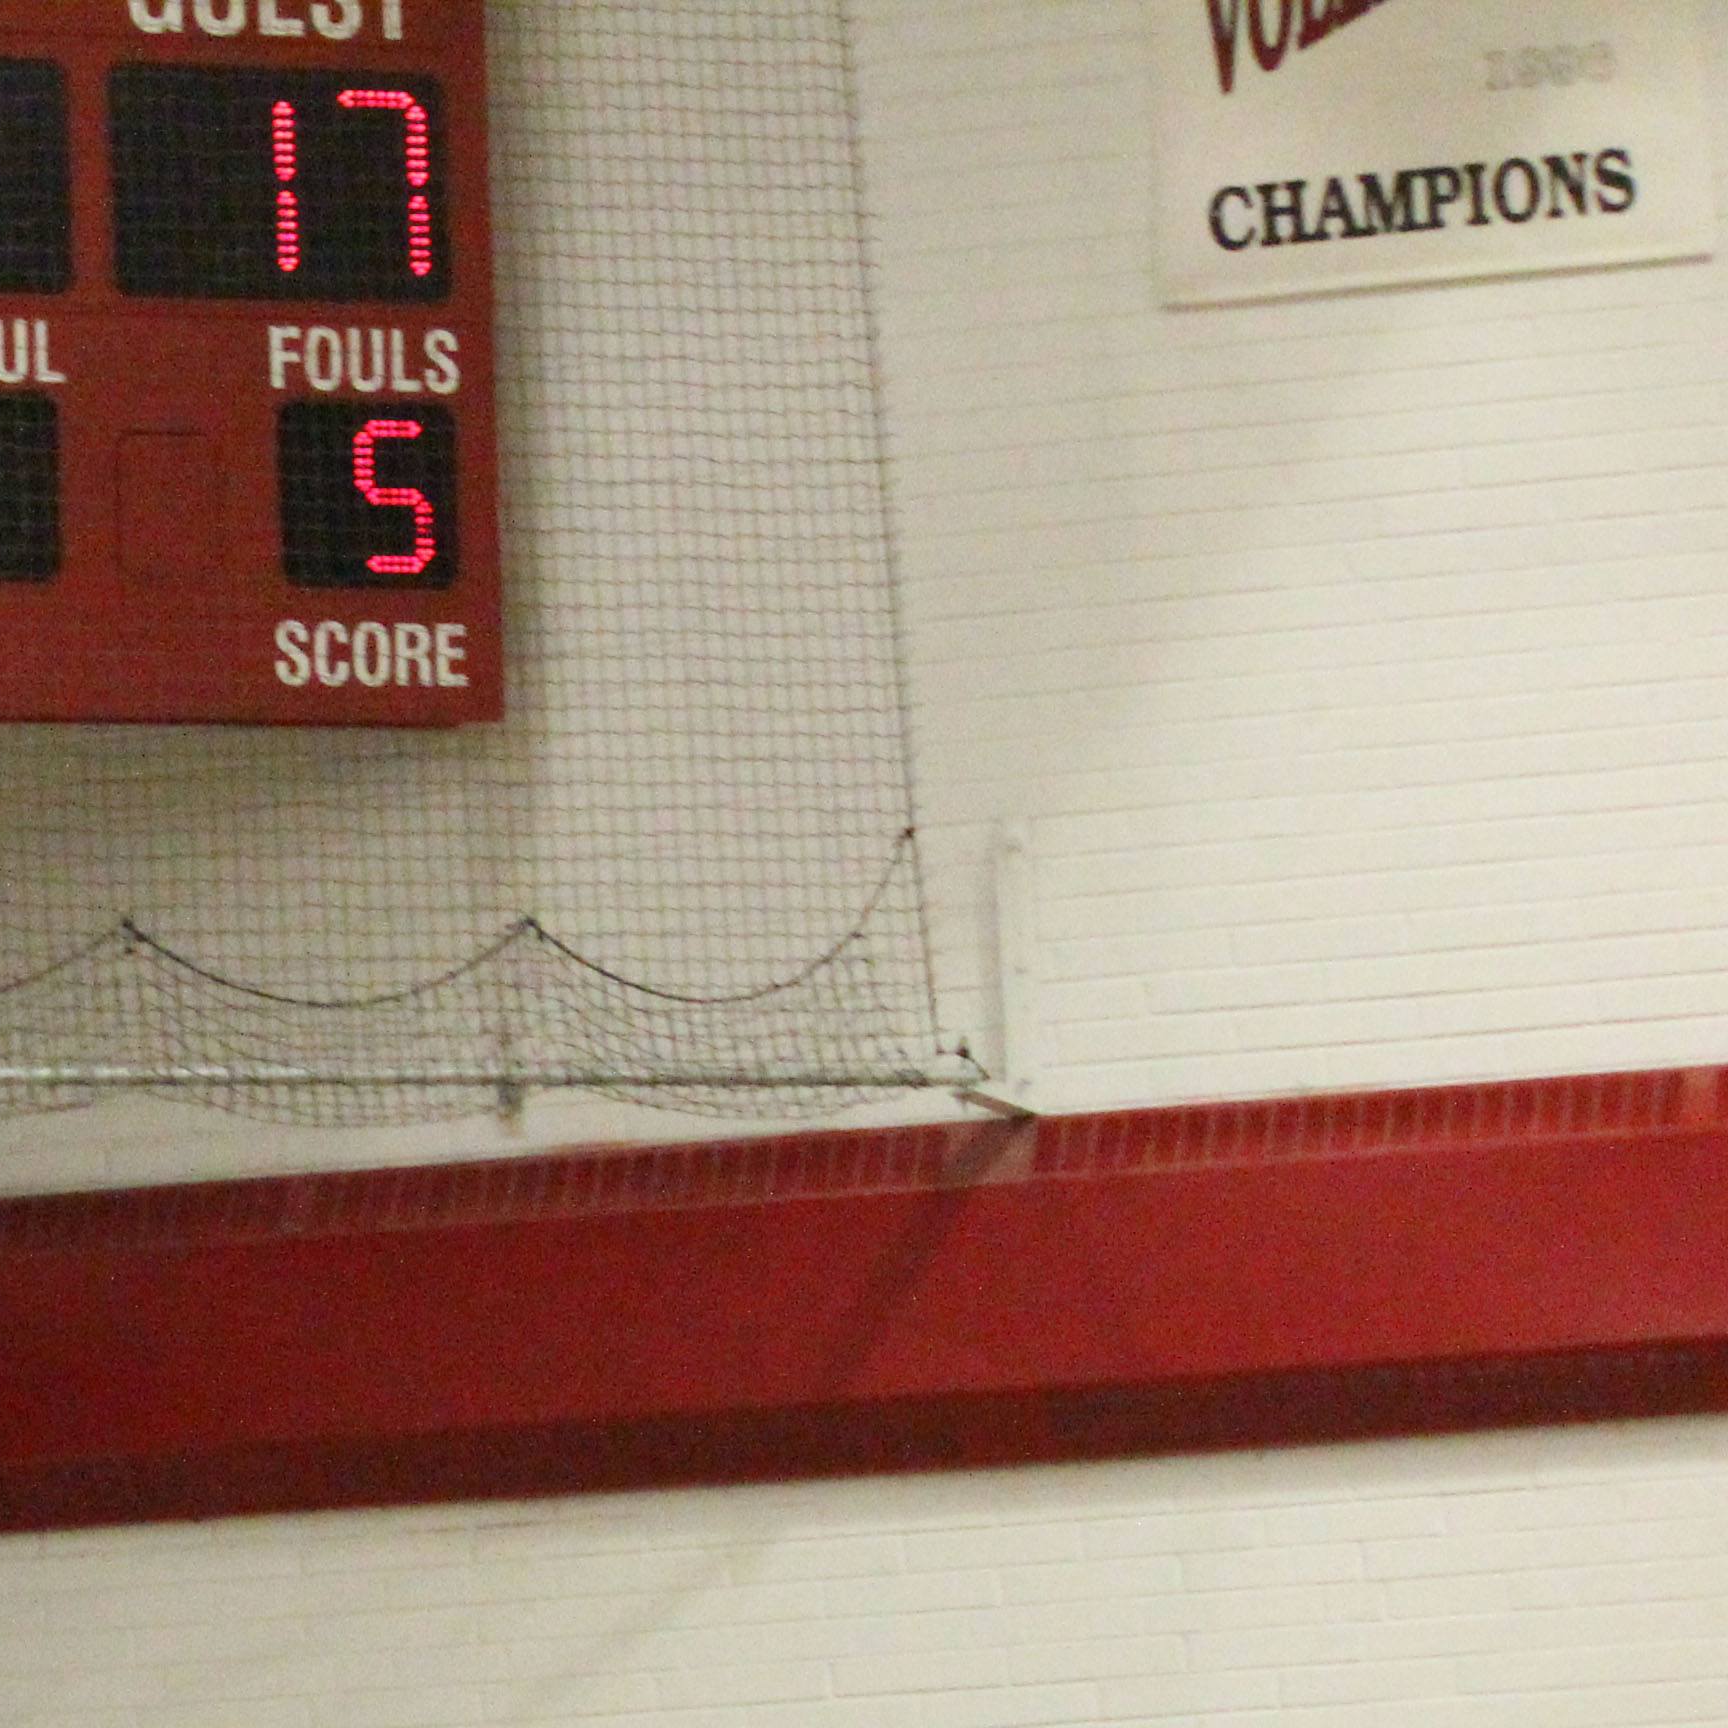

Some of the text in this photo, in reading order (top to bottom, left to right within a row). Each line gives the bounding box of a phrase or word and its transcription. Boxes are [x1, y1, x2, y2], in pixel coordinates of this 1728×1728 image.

[270, 89, 432, 277] 17
[1207, 148, 1636, 252] CHAMPIONS
[267, 324, 461, 394] FOULS
[352, 419, 436, 575] 5
[274, 619, 470, 689] SCORE
